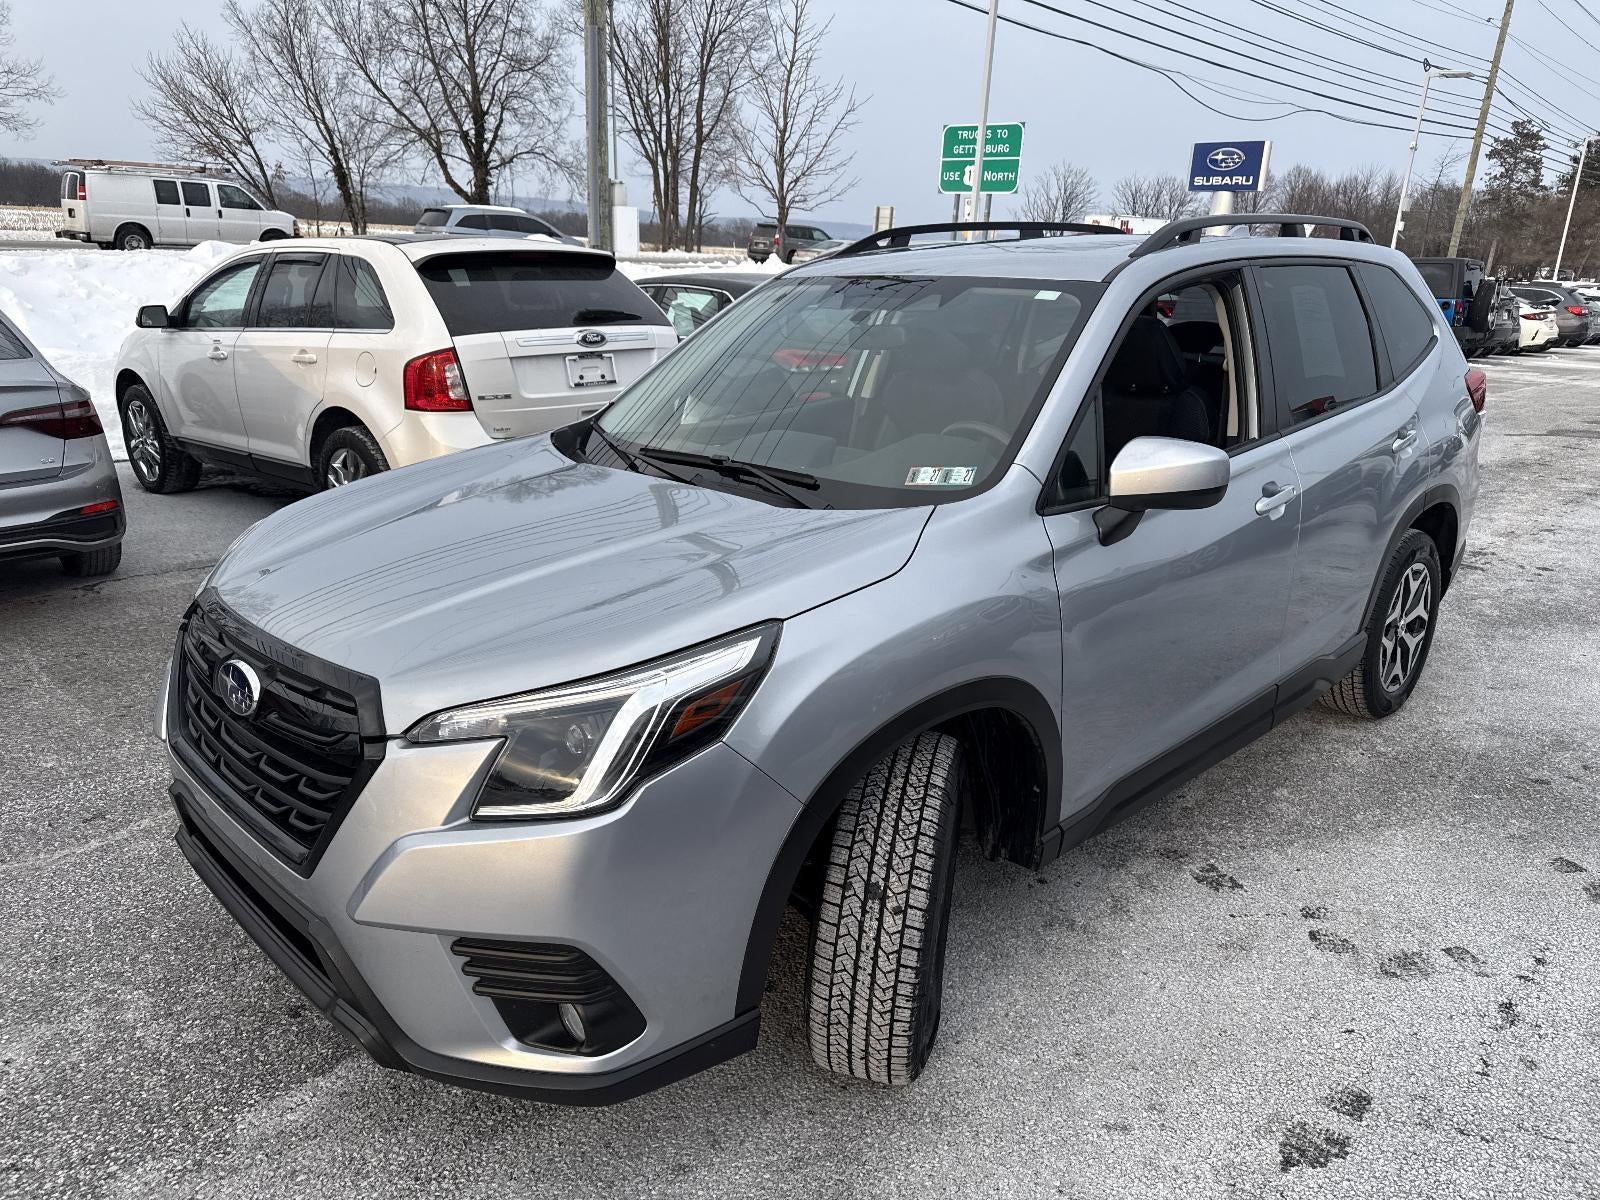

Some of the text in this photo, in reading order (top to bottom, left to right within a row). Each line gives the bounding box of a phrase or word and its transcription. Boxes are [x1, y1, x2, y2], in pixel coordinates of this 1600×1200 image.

[957, 129, 1009, 140] TRUCS TO
[953, 144, 1010, 154] GETTYBURG
[943, 171, 961, 181] USE
[1193, 175, 1254, 186] SUBARU
